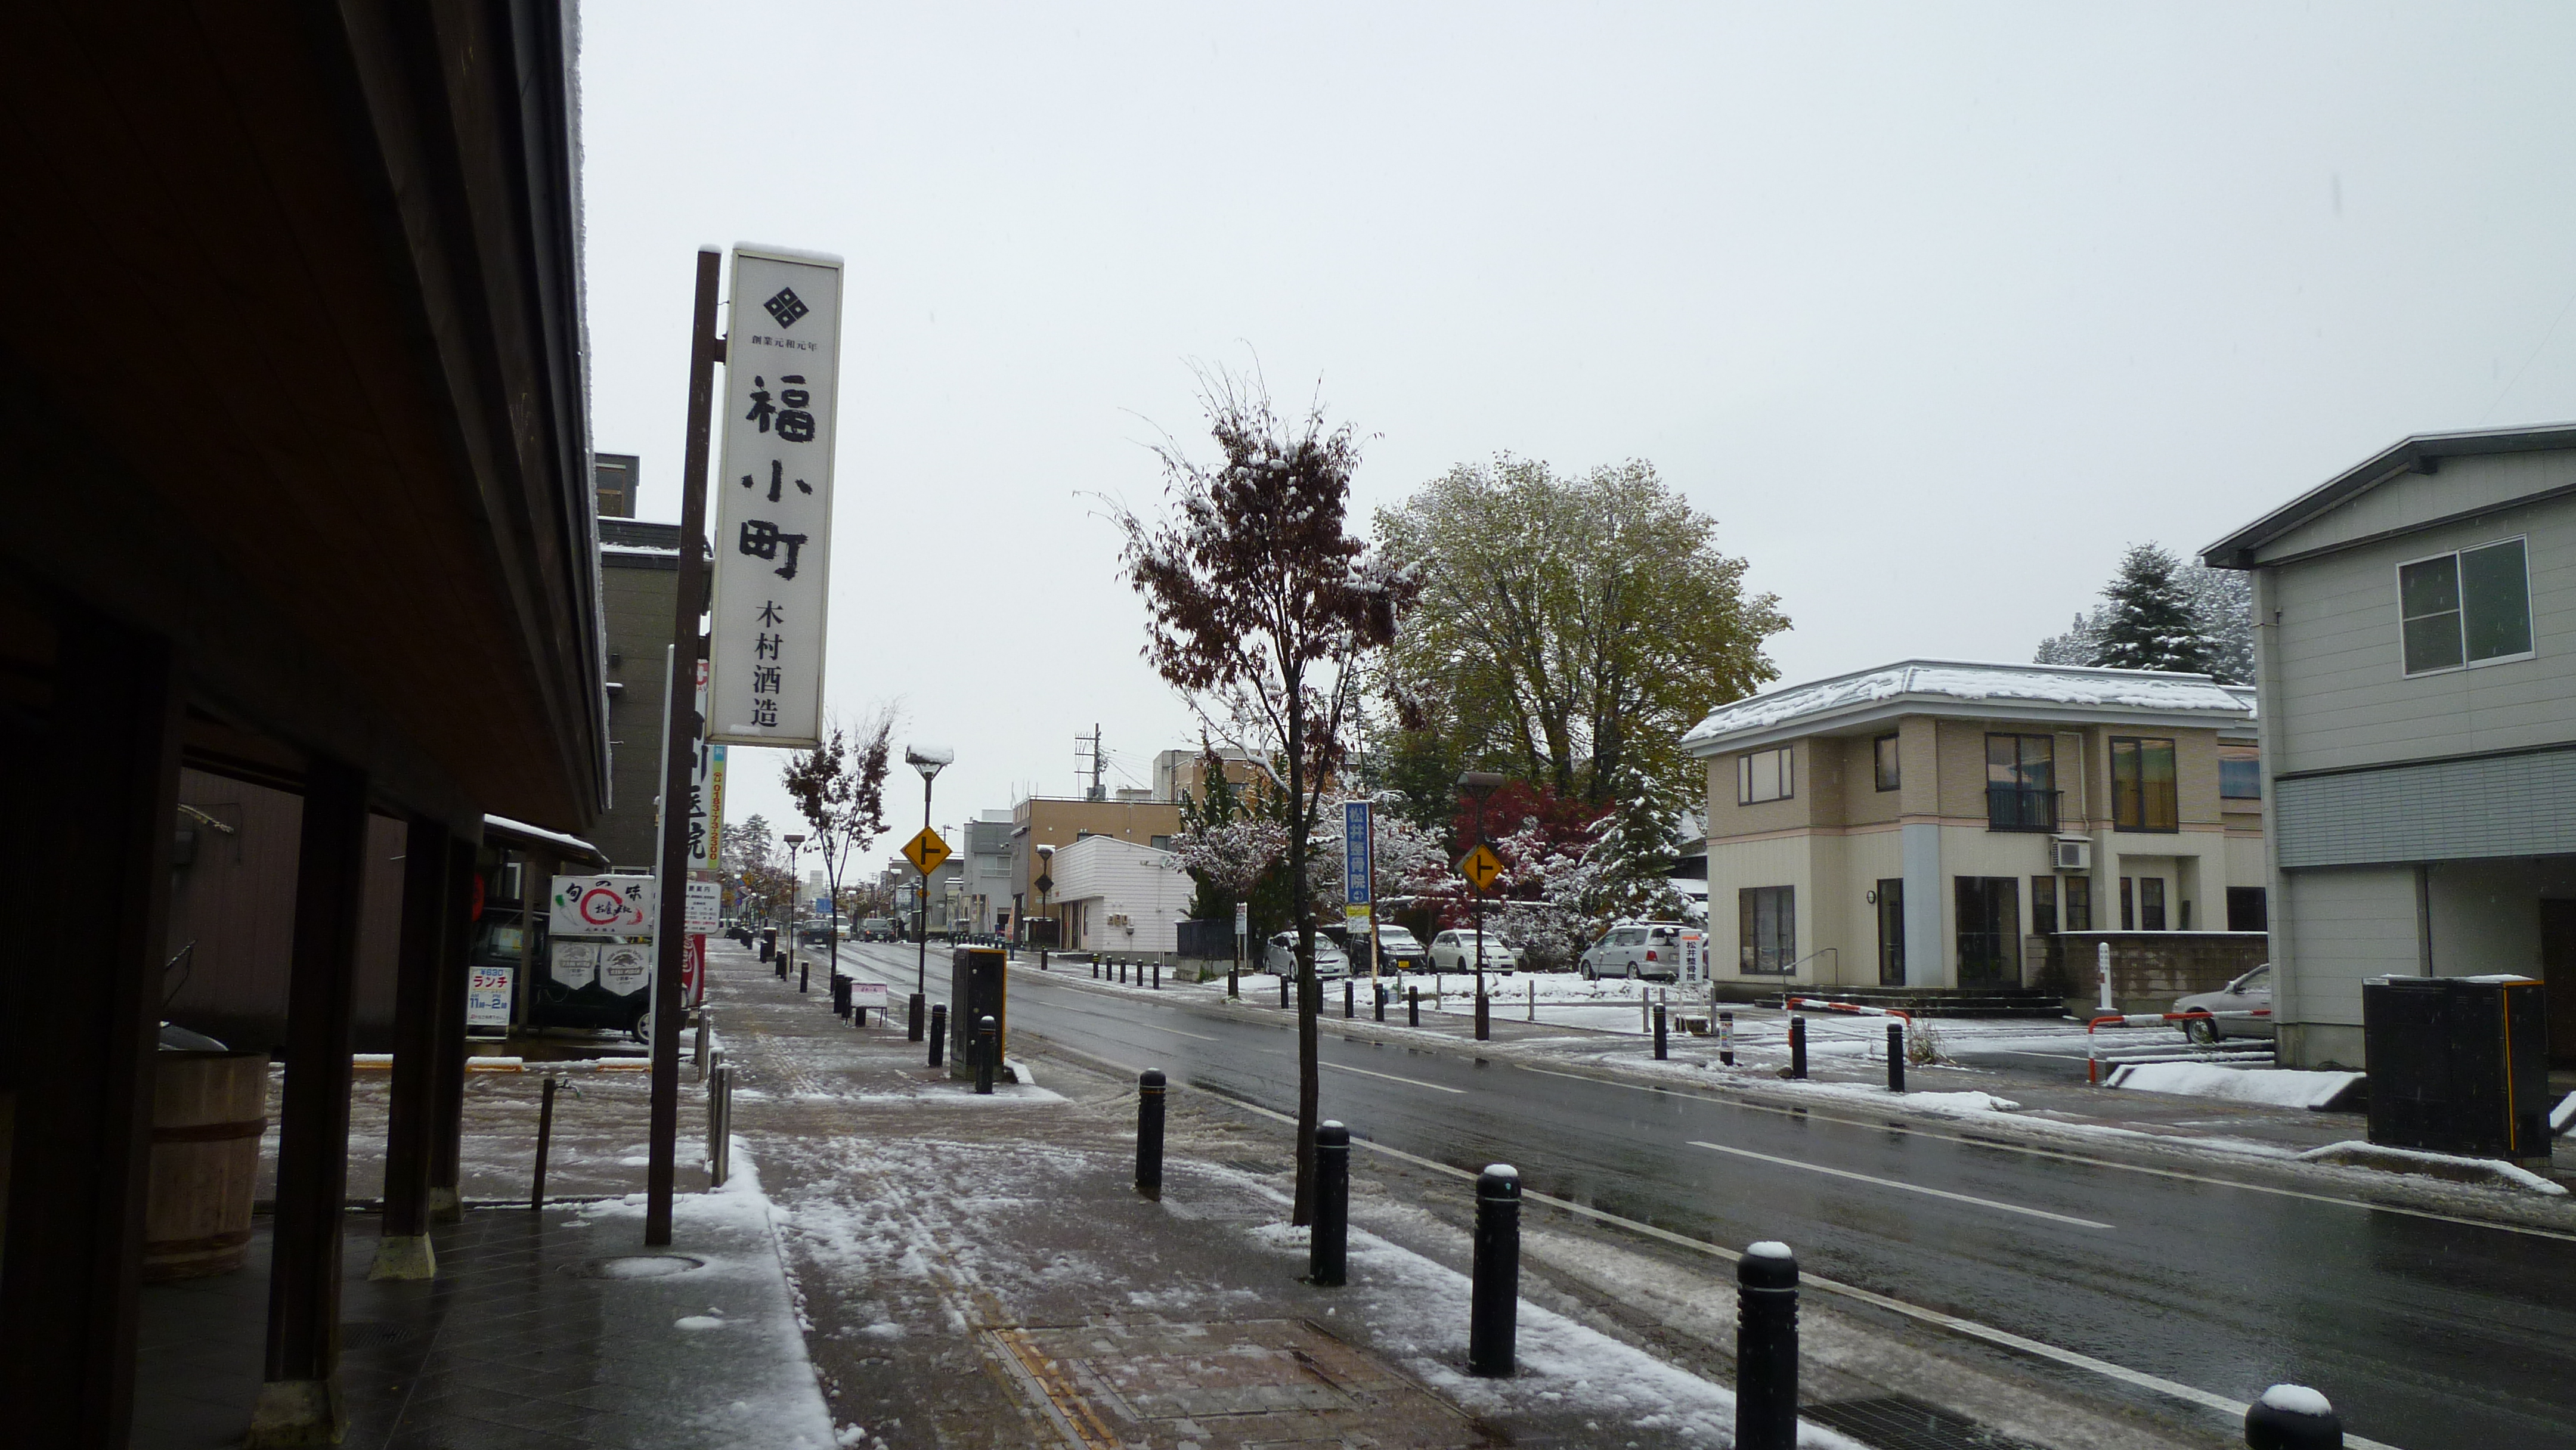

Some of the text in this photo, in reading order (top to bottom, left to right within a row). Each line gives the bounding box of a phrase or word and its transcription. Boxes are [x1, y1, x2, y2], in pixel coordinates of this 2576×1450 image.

[751, 335, 818, 352] 創業元和元年
[738, 374, 816, 581] 福小町
[750, 599, 784, 728] 木村酒造
[710, 784, 721, 860] 0183-73-2300
[1349, 807, 1366, 889] 松井整骨院
[566, 880, 642, 903] 旬の味
[473, 975, 507, 988] ランチ
[1686, 941, 1696, 981] 松井整骨院
